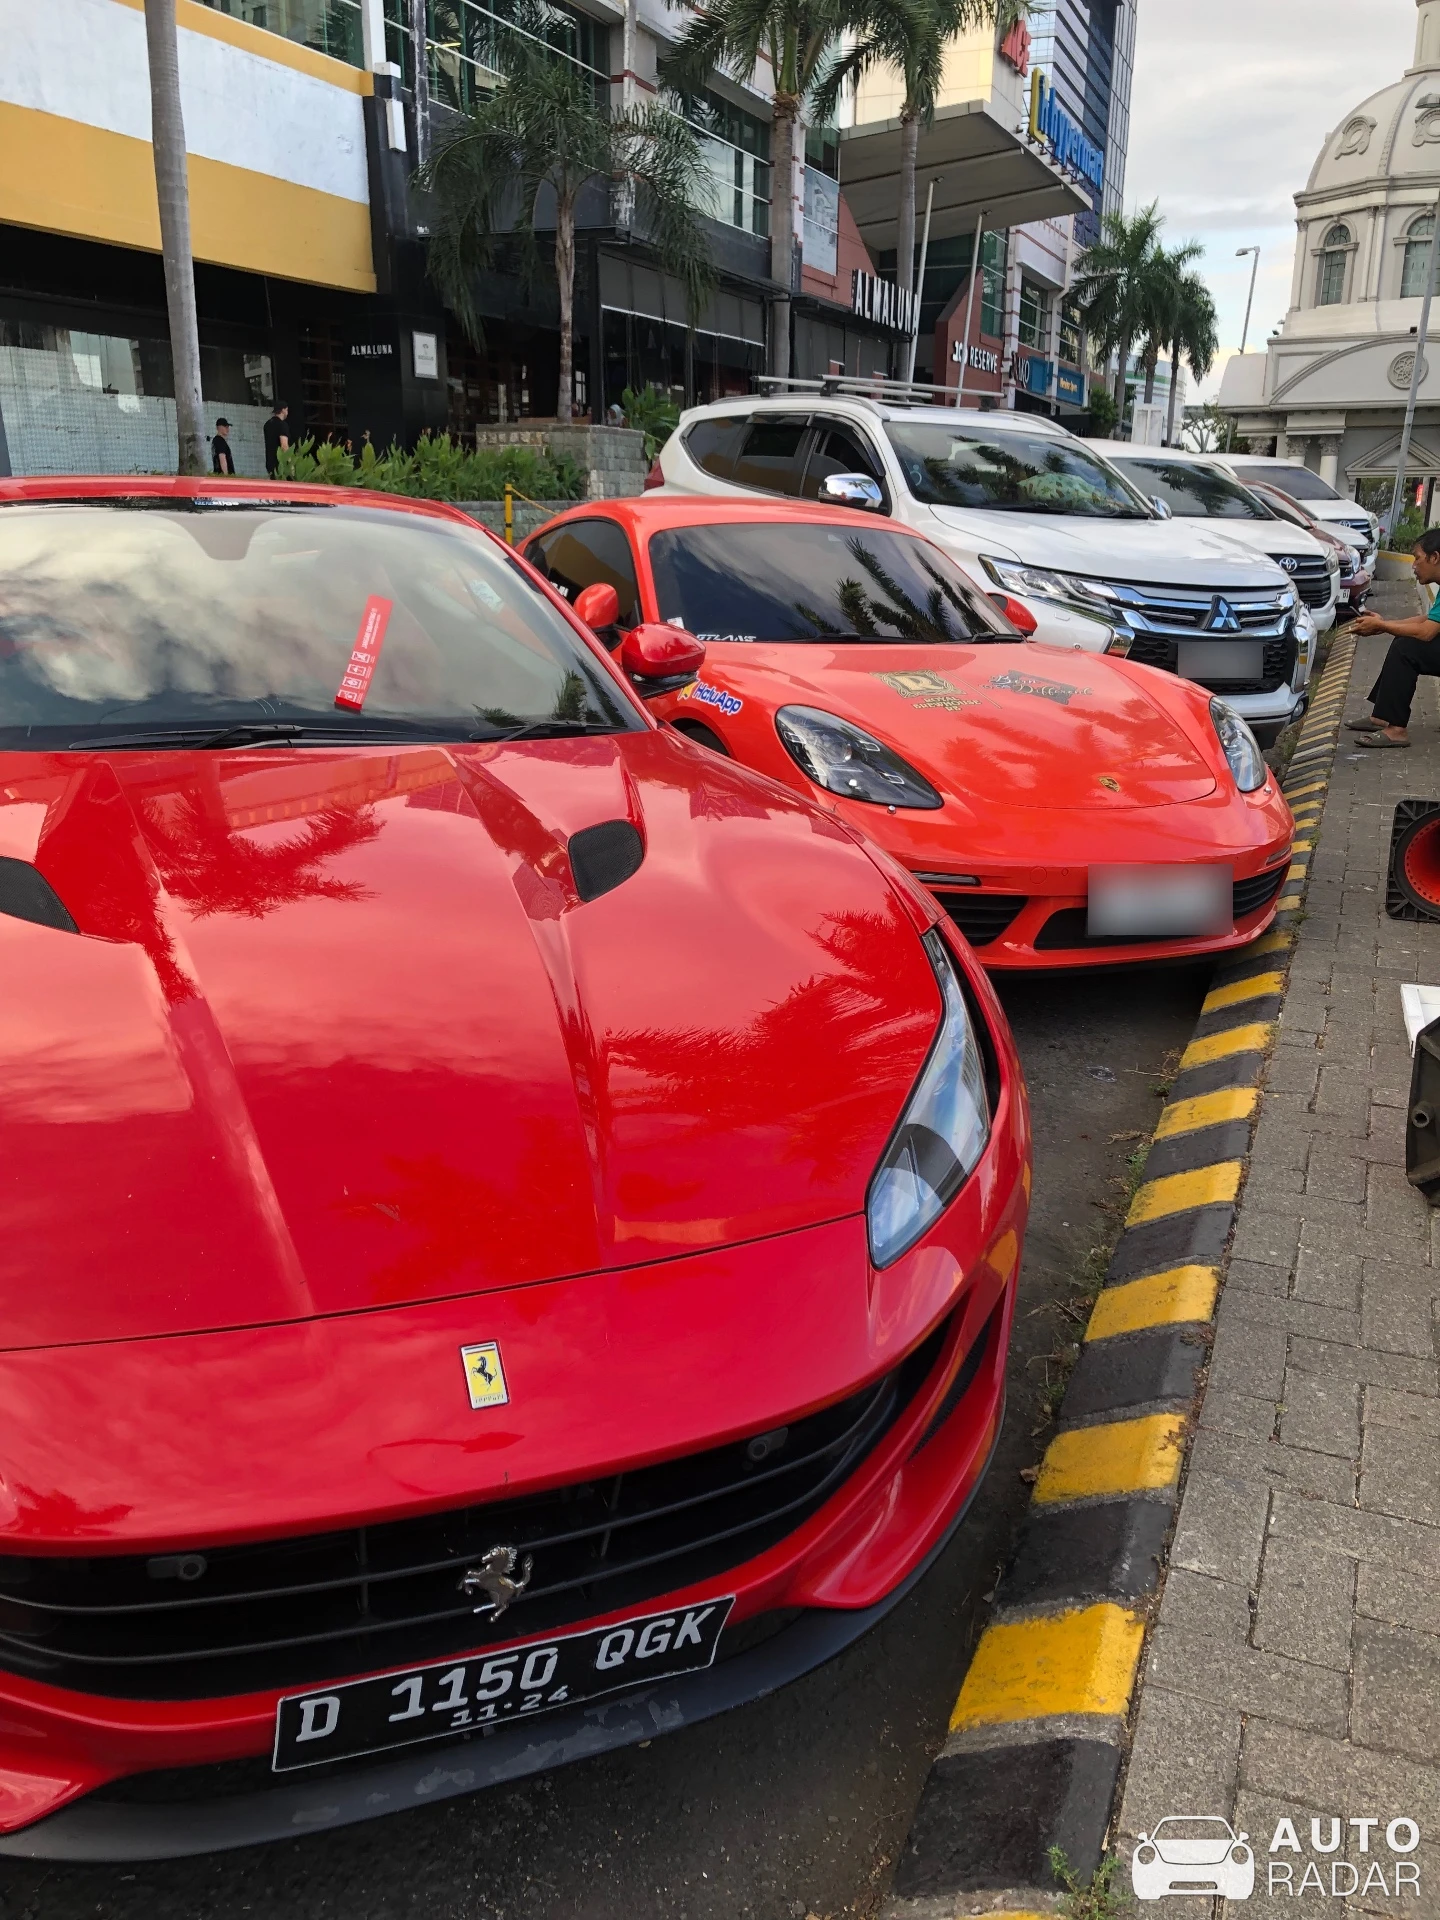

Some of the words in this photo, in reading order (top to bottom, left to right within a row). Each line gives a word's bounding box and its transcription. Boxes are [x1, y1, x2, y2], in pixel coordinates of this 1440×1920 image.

[855, 269, 920, 336] ALMALUNA
[969, 345, 998, 374] RESERVE
[693, 682, 743, 715] HaluApp
[296, 1697, 341, 1742] D
[388, 1647, 559, 1723] 1150
[595, 1606, 716, 1671] QGK
